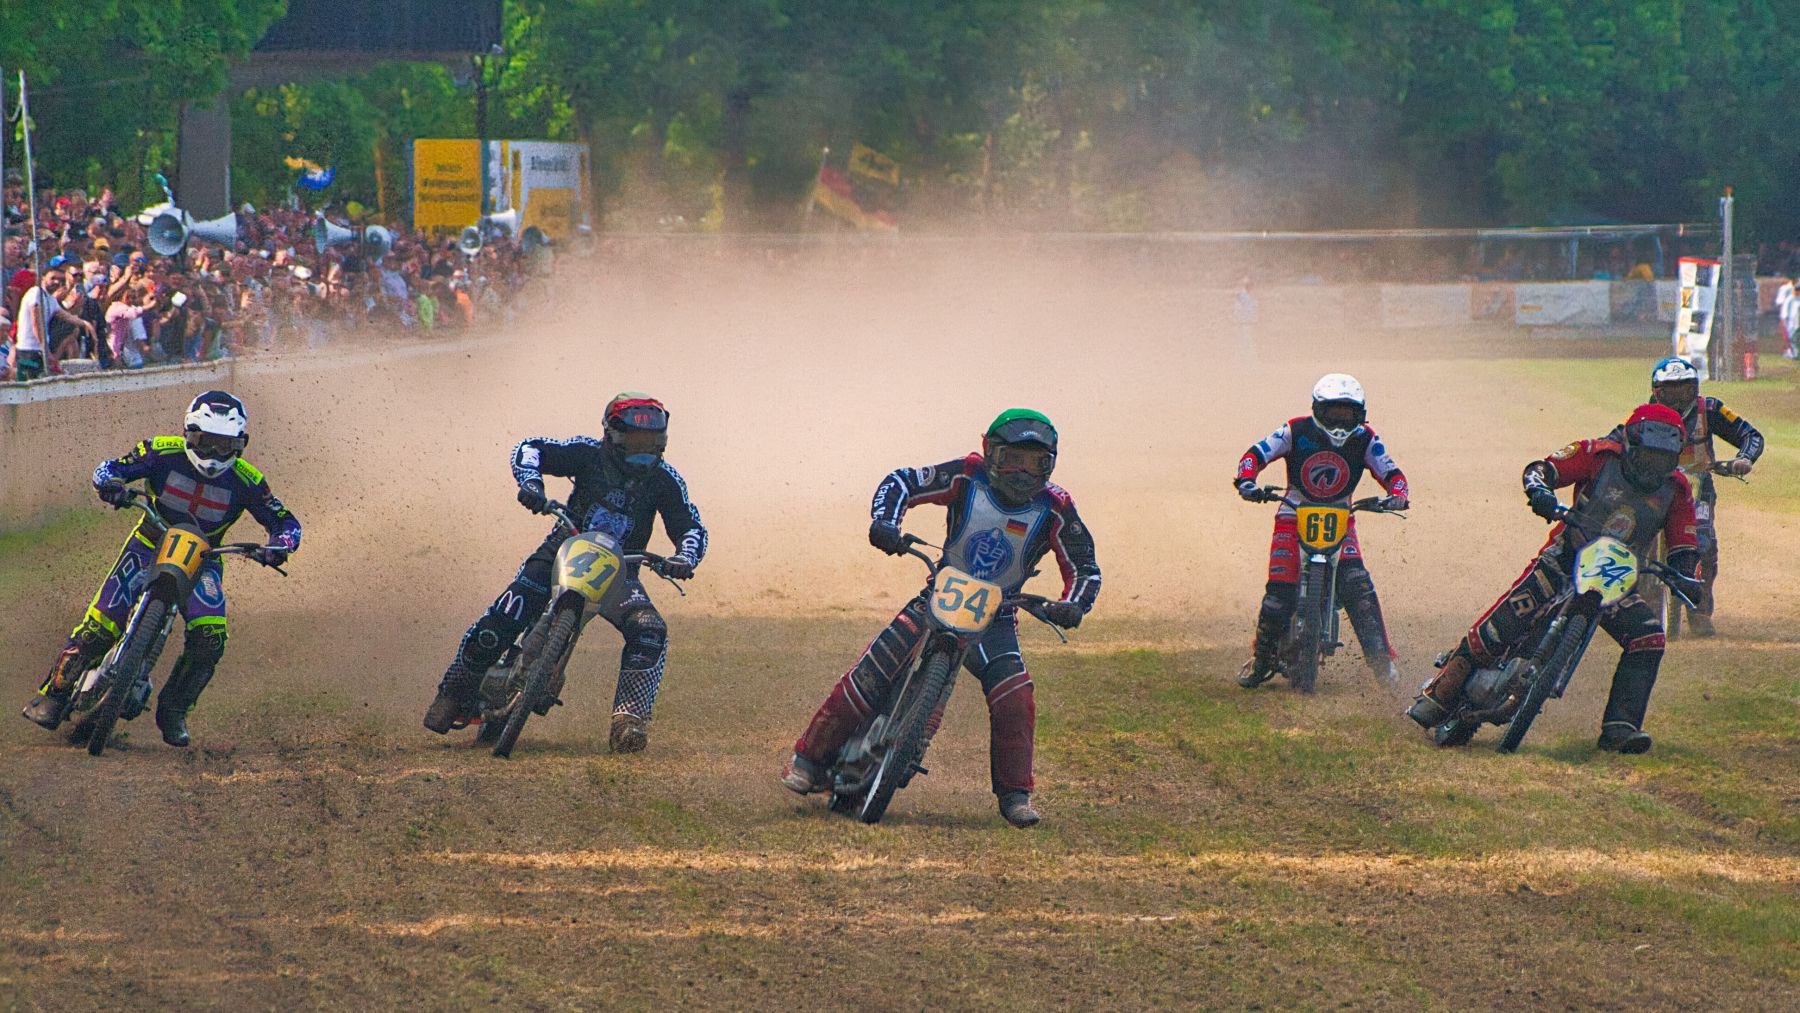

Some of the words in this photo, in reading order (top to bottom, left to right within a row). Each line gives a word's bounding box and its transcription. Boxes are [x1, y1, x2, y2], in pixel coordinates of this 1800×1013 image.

[1306, 513, 1337, 542] 69
[166, 533, 198, 566] 11
[567, 551, 617, 590] 41
[1582, 556, 1634, 588] 34
[937, 576, 990, 624] 54
